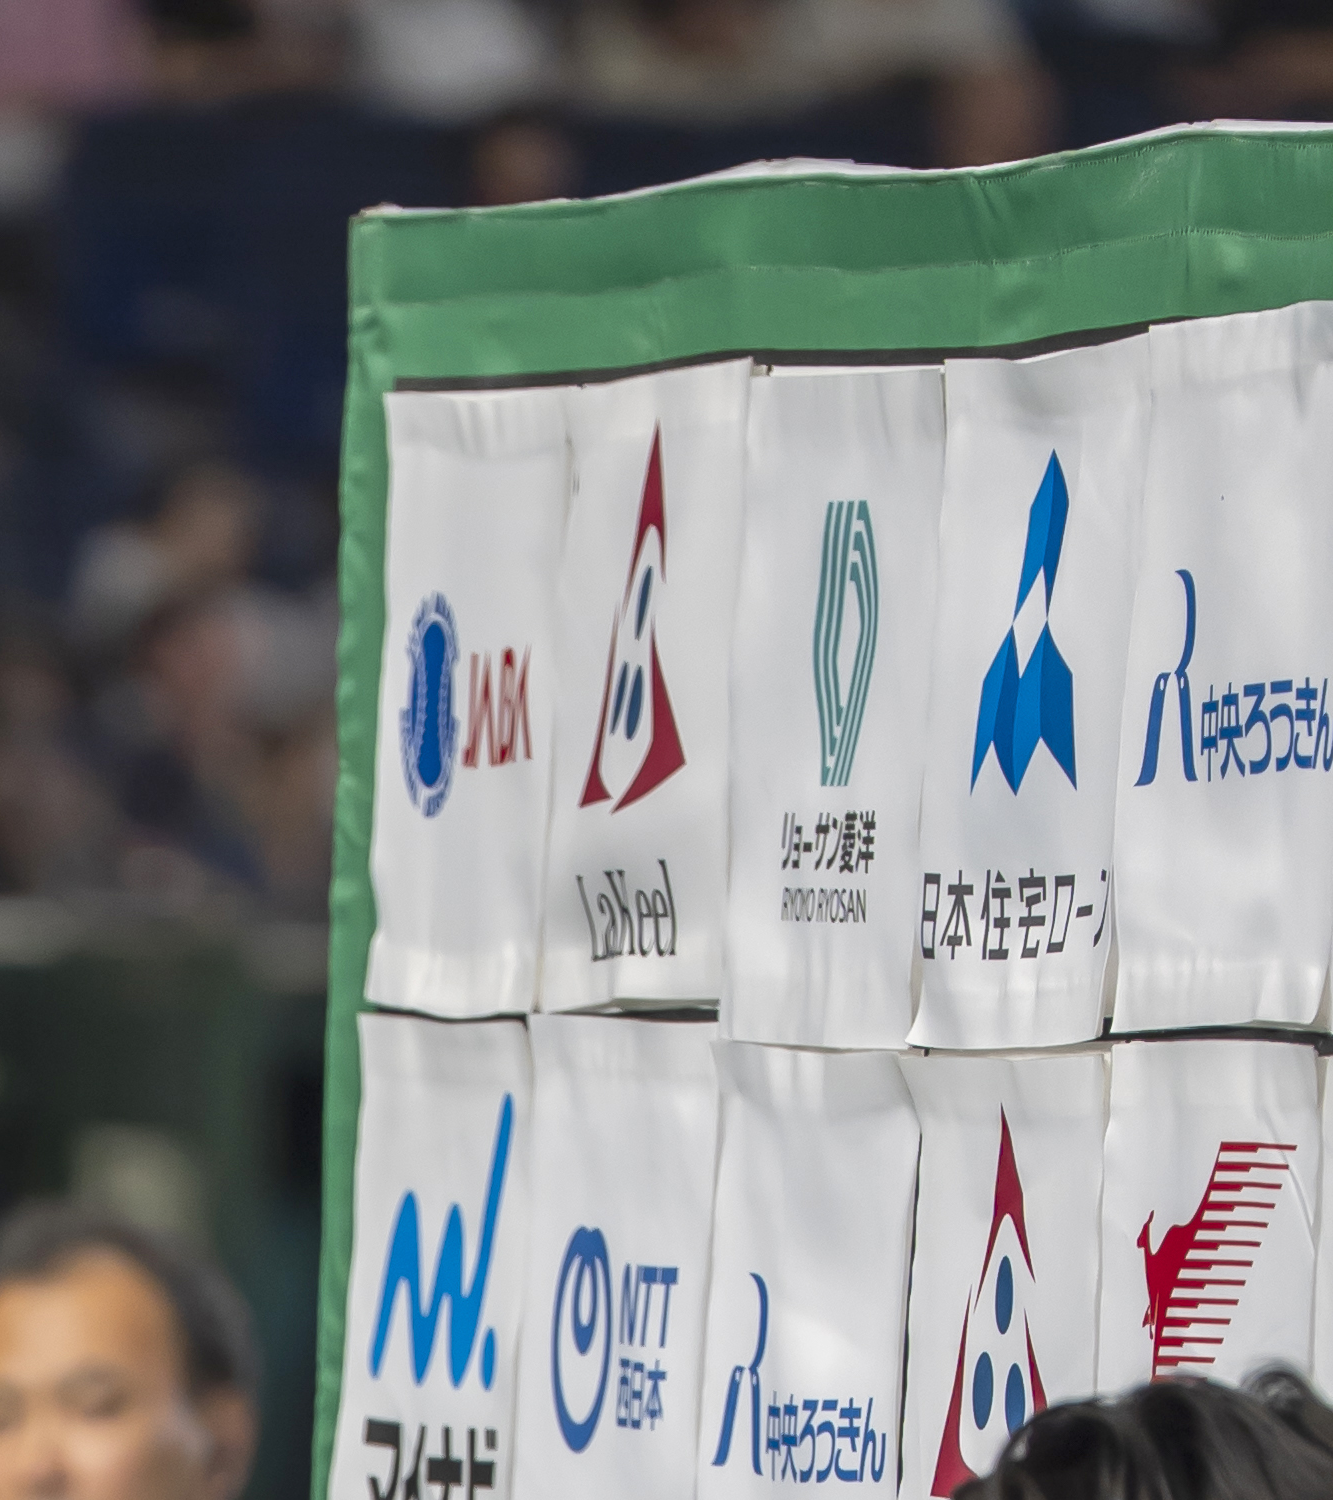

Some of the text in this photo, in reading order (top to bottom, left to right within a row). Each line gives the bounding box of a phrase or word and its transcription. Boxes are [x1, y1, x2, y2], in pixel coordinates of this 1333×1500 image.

[462, 644, 532, 768] JABA
[1200, 677, 1333, 782] 中央ろうきん
[782, 810, 876, 874] リョーサン菱洋
[576, 859, 676, 962] LaKeel
[816, 887, 867, 923] RYOSAN
[921, 868, 1110, 960] 日本住宅ローン
[619, 1263, 678, 1348] NTT
[617, 1358, 667, 1431] 西日本
[766, 1390, 887, 1484] 中央ろうきん
